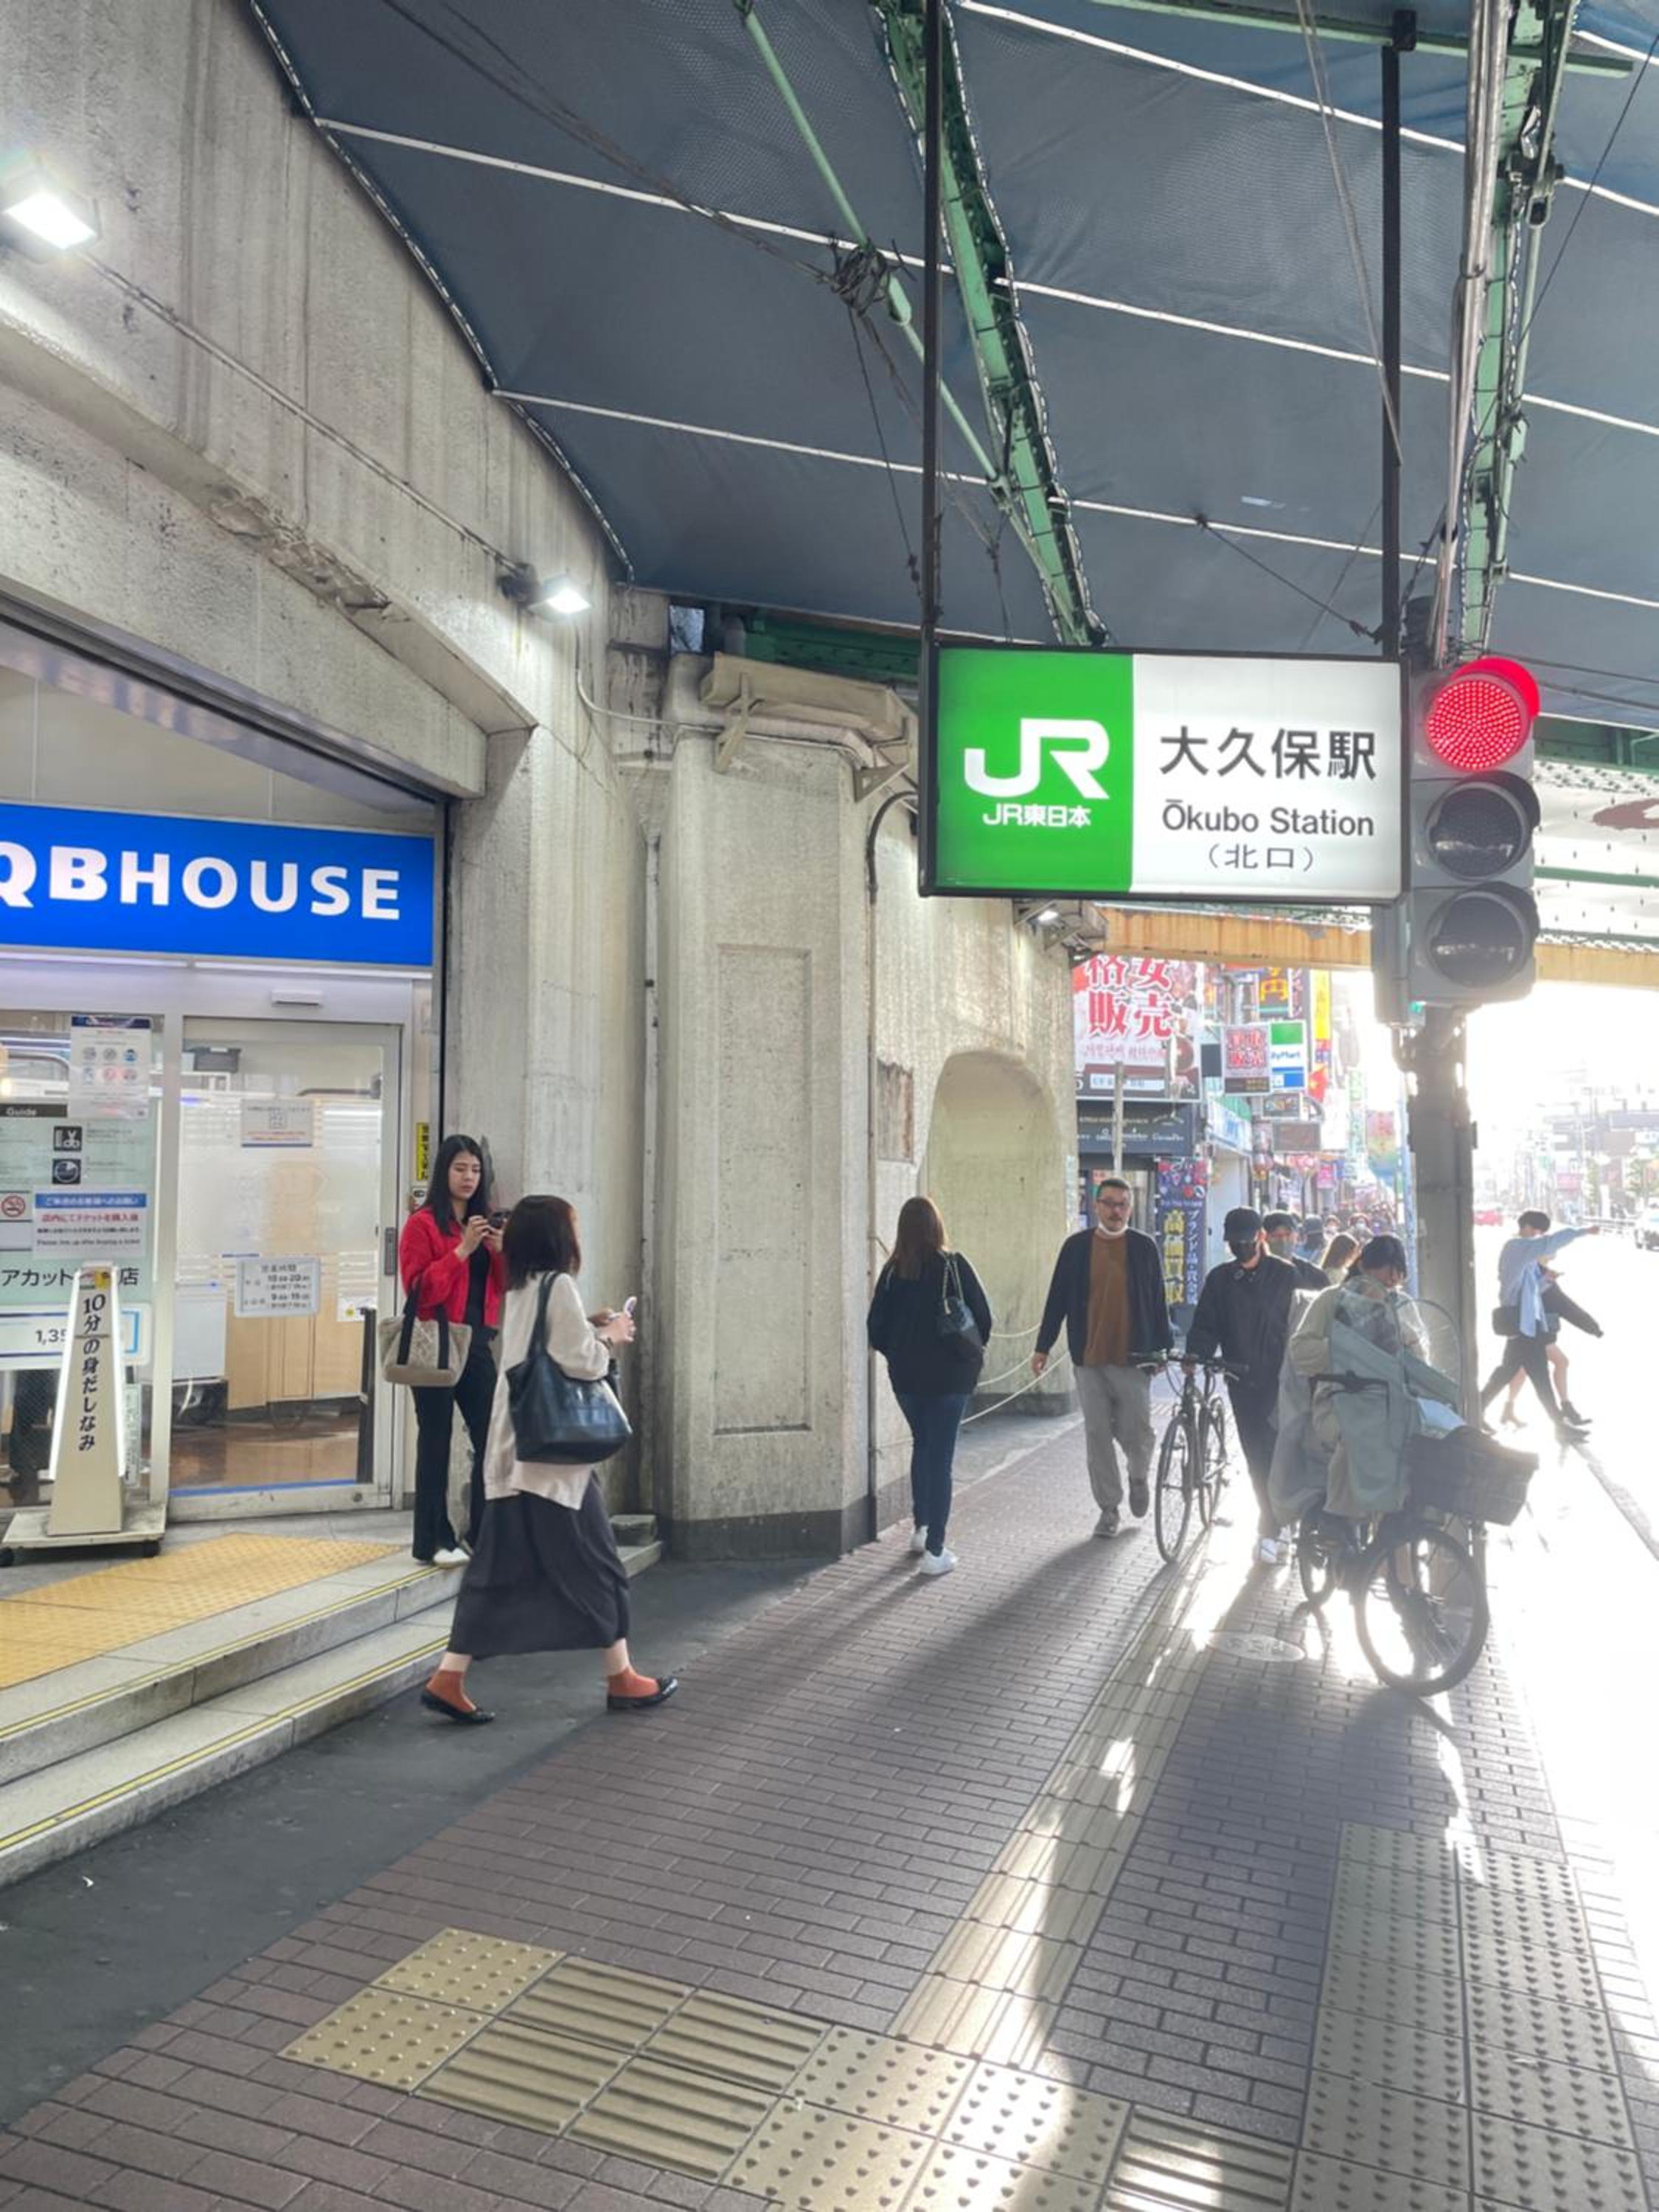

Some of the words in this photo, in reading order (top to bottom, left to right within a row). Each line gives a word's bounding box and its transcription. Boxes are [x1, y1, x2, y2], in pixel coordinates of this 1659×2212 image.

[964, 718, 1109, 799] JR
[1160, 726, 1377, 781] 大久保駅
[983, 804, 1091, 827] JR東日本
[1163, 799, 1259, 832] Ōkubo
[1270, 807, 1374, 835] Station
[1088, 992, 1172, 1037] 販売
[6, 1107, 38, 1116] Guide
